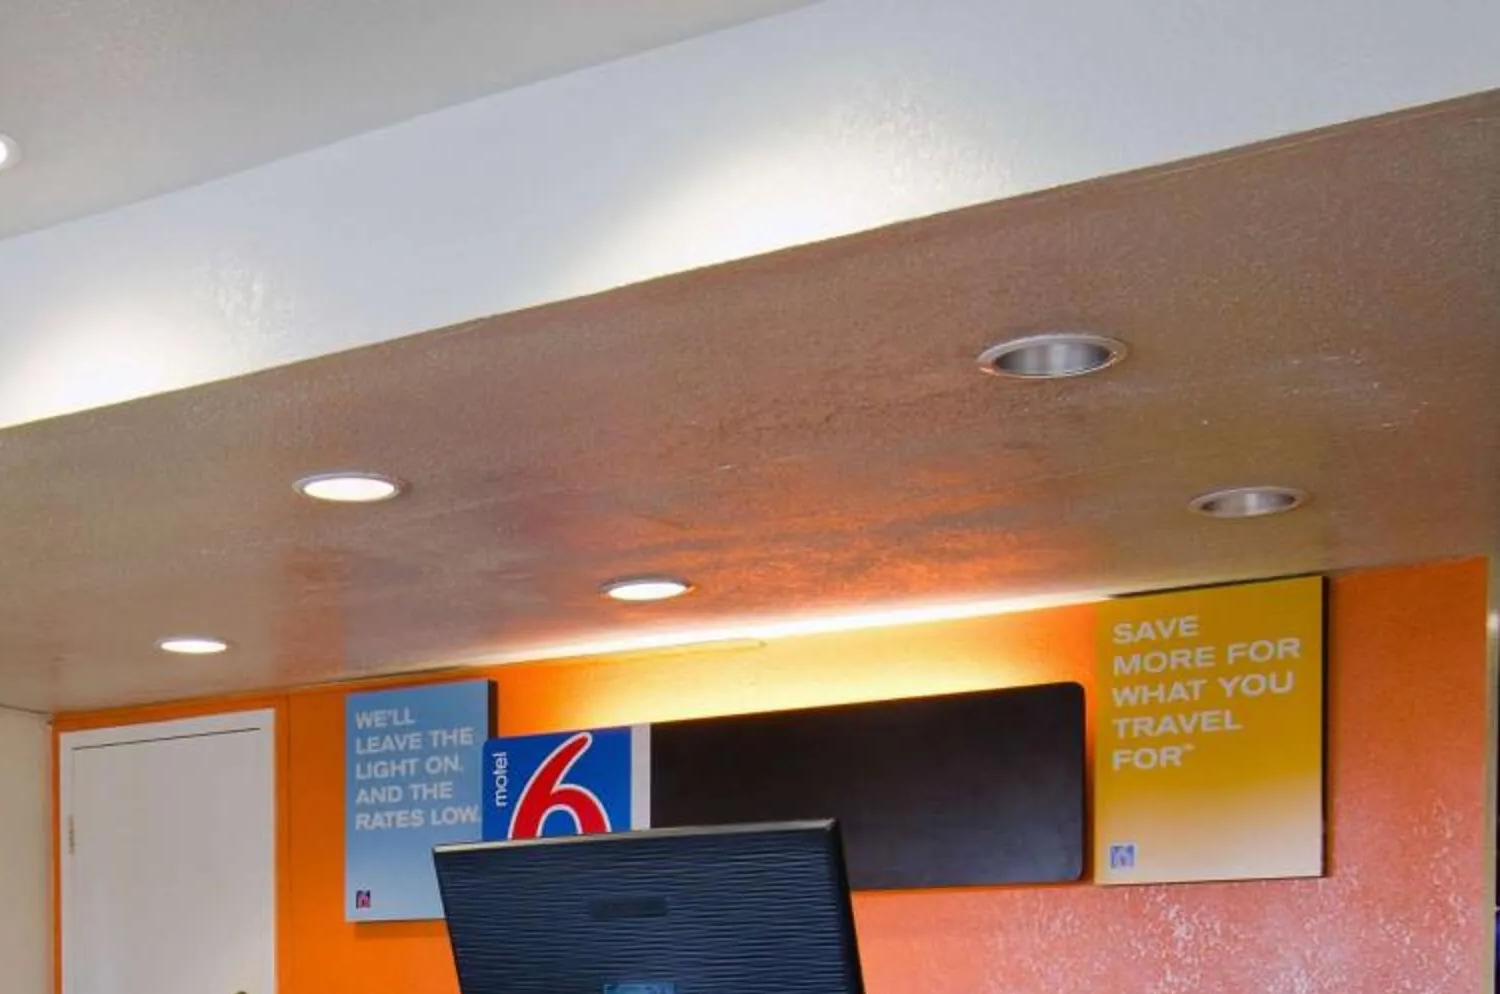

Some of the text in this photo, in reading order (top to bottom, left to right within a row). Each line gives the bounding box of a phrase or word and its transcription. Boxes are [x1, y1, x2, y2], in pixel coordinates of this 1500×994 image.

[1112, 615, 1199, 645] SAVE
[1112, 637, 1301, 676] MORE FOR
[1112, 671, 1295, 708] WHAT YOU
[355, 708, 416, 730] WE'LL
[1112, 709, 1243, 739] TRAVEL
[355, 727, 474, 755] LEAVE THE
[355, 758, 418, 780] LIGHT
[493, 752, 508, 807] motel
[355, 781, 453, 805] AND THE
[507, 731, 612, 841] 6
[355, 809, 425, 831] RATES
